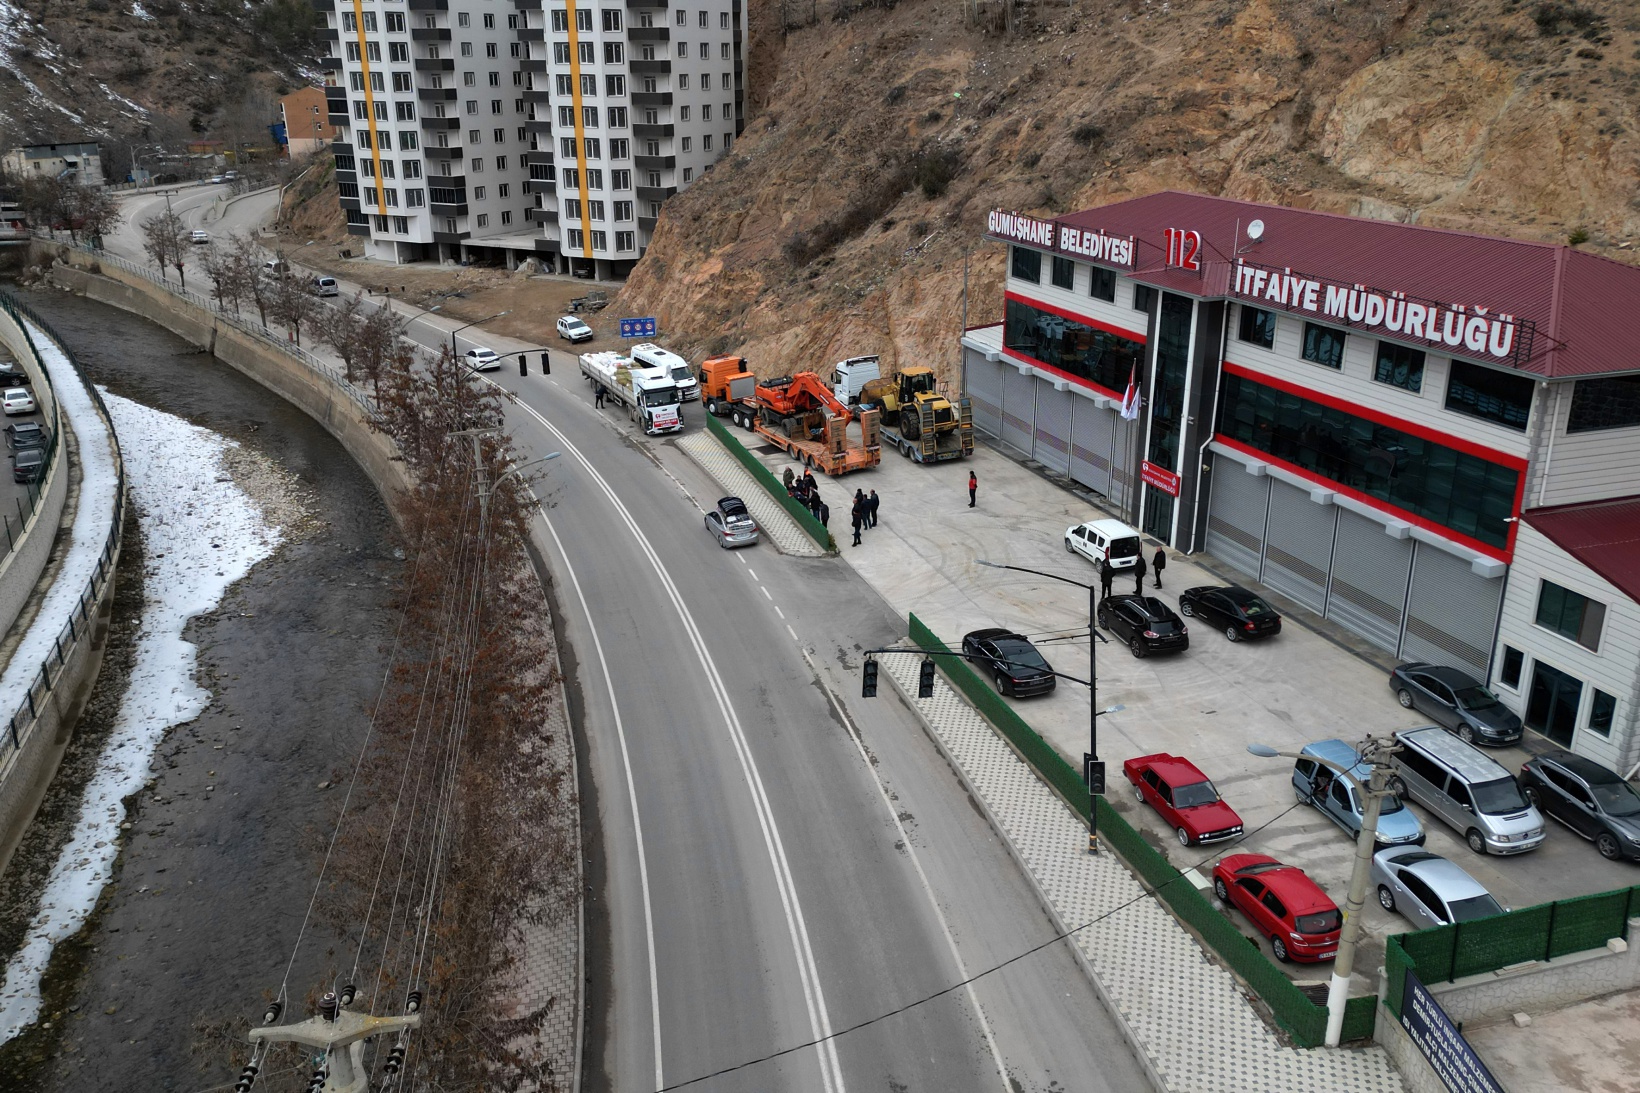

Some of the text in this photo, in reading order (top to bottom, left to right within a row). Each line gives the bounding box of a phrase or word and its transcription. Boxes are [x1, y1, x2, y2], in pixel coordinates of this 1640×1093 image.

[988, 207, 1135, 266] GÜMÜŞHANE BELEDİYESİ
[1164, 227, 1201, 271] 112
[1235, 257, 1516, 357] İTFAİYE MÜDÜRLÜĞÜ
[1410, 1024, 1430, 1058] YALITIM
[1414, 985, 1425, 1005] HER
[1426, 1001, 1443, 1028] TÜRLÜ
[1443, 1023, 1463, 1055] İNŞAAT
[1425, 1031, 1437, 1052] ALÇI
